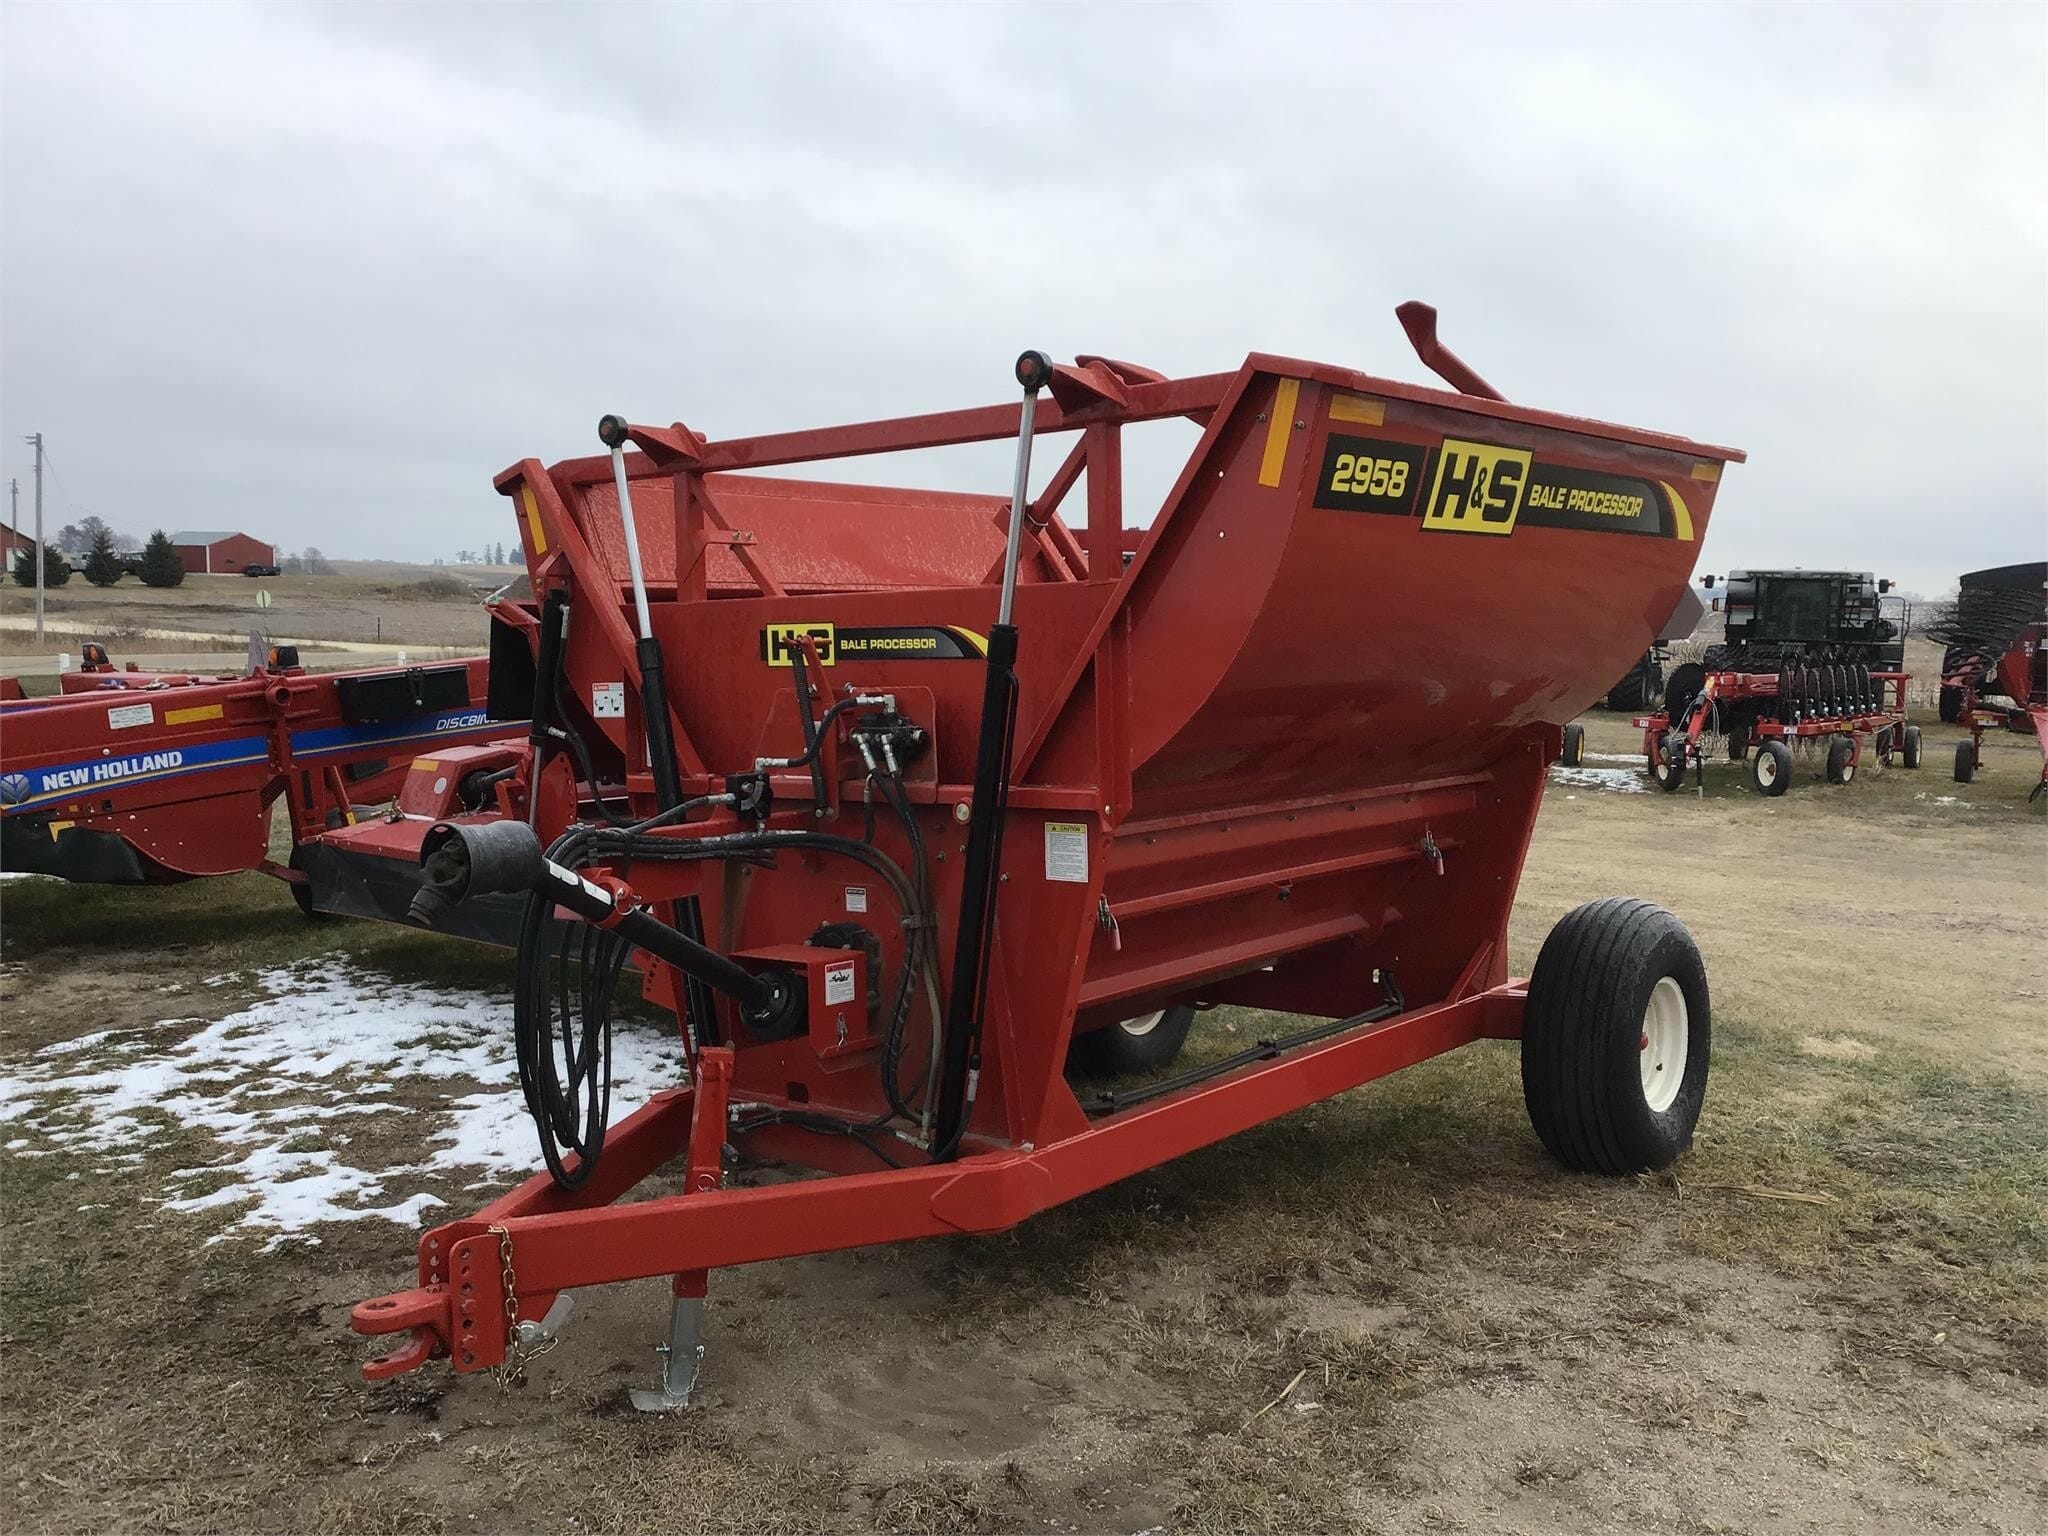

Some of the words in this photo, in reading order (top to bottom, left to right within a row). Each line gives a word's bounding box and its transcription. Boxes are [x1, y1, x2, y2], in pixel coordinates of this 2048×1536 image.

[1331, 454, 1410, 498] 2958
[1431, 451, 1524, 524] H&S
[1528, 484, 1569, 511] BALE
[1566, 488, 1644, 518] PROCESSOR
[771, 628, 831, 661] HS
[840, 639, 868, 650] BALE
[869, 638, 937, 650] PROCESSOR
[42, 767, 90, 792] NEW
[94, 751, 183, 782] HOLLAND
